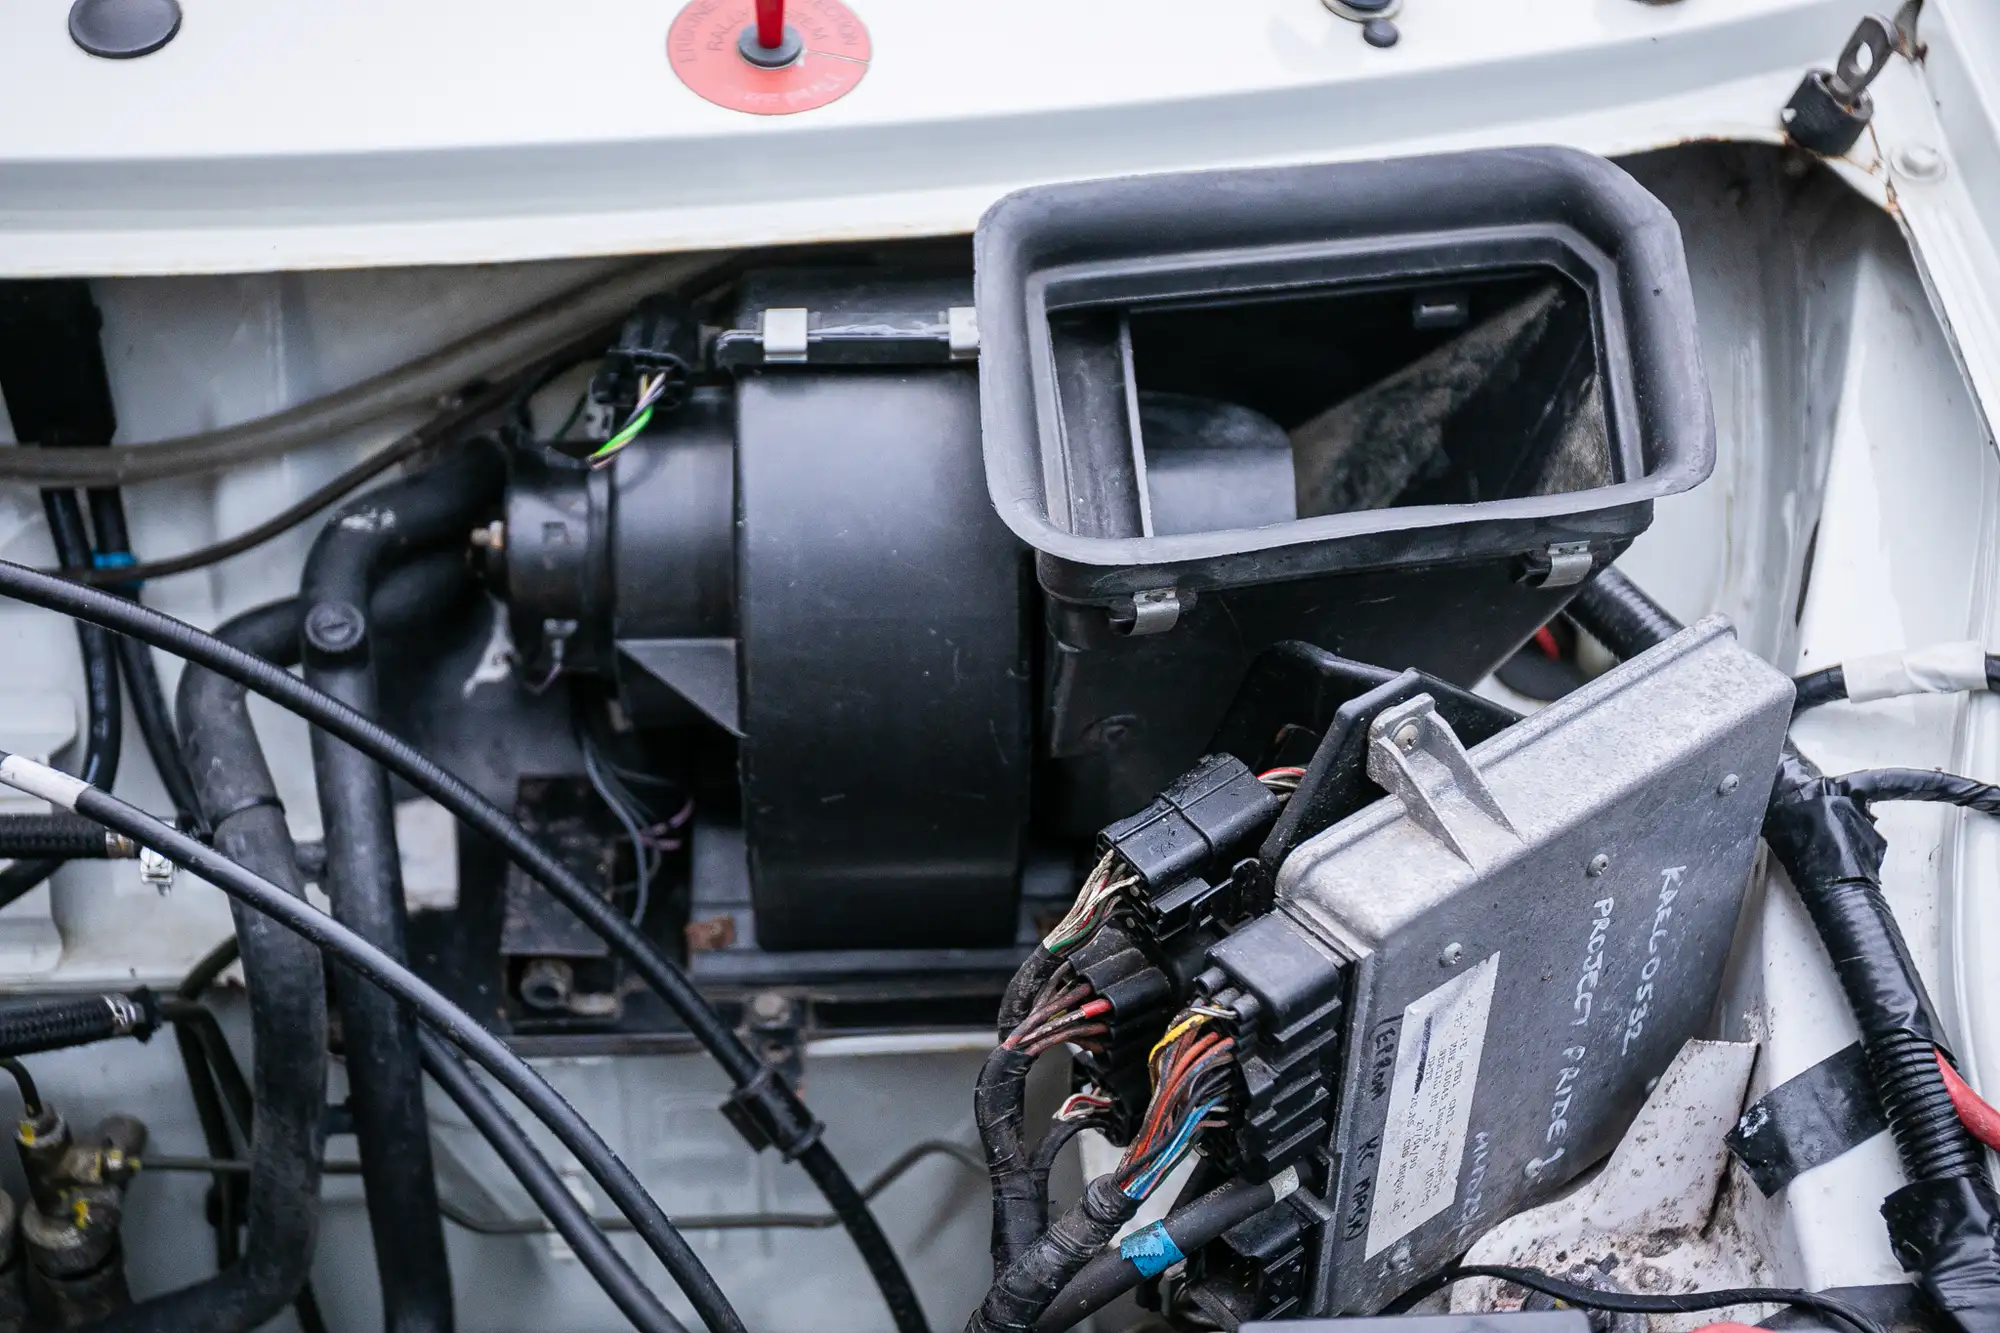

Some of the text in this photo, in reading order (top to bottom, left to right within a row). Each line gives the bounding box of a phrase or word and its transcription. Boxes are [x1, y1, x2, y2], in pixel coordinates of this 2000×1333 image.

[1570, 896, 1615, 1027] PROJECT
[1423, 1053, 1436, 1084] DATE
[1546, 1044, 1586, 1143] PRIDE
